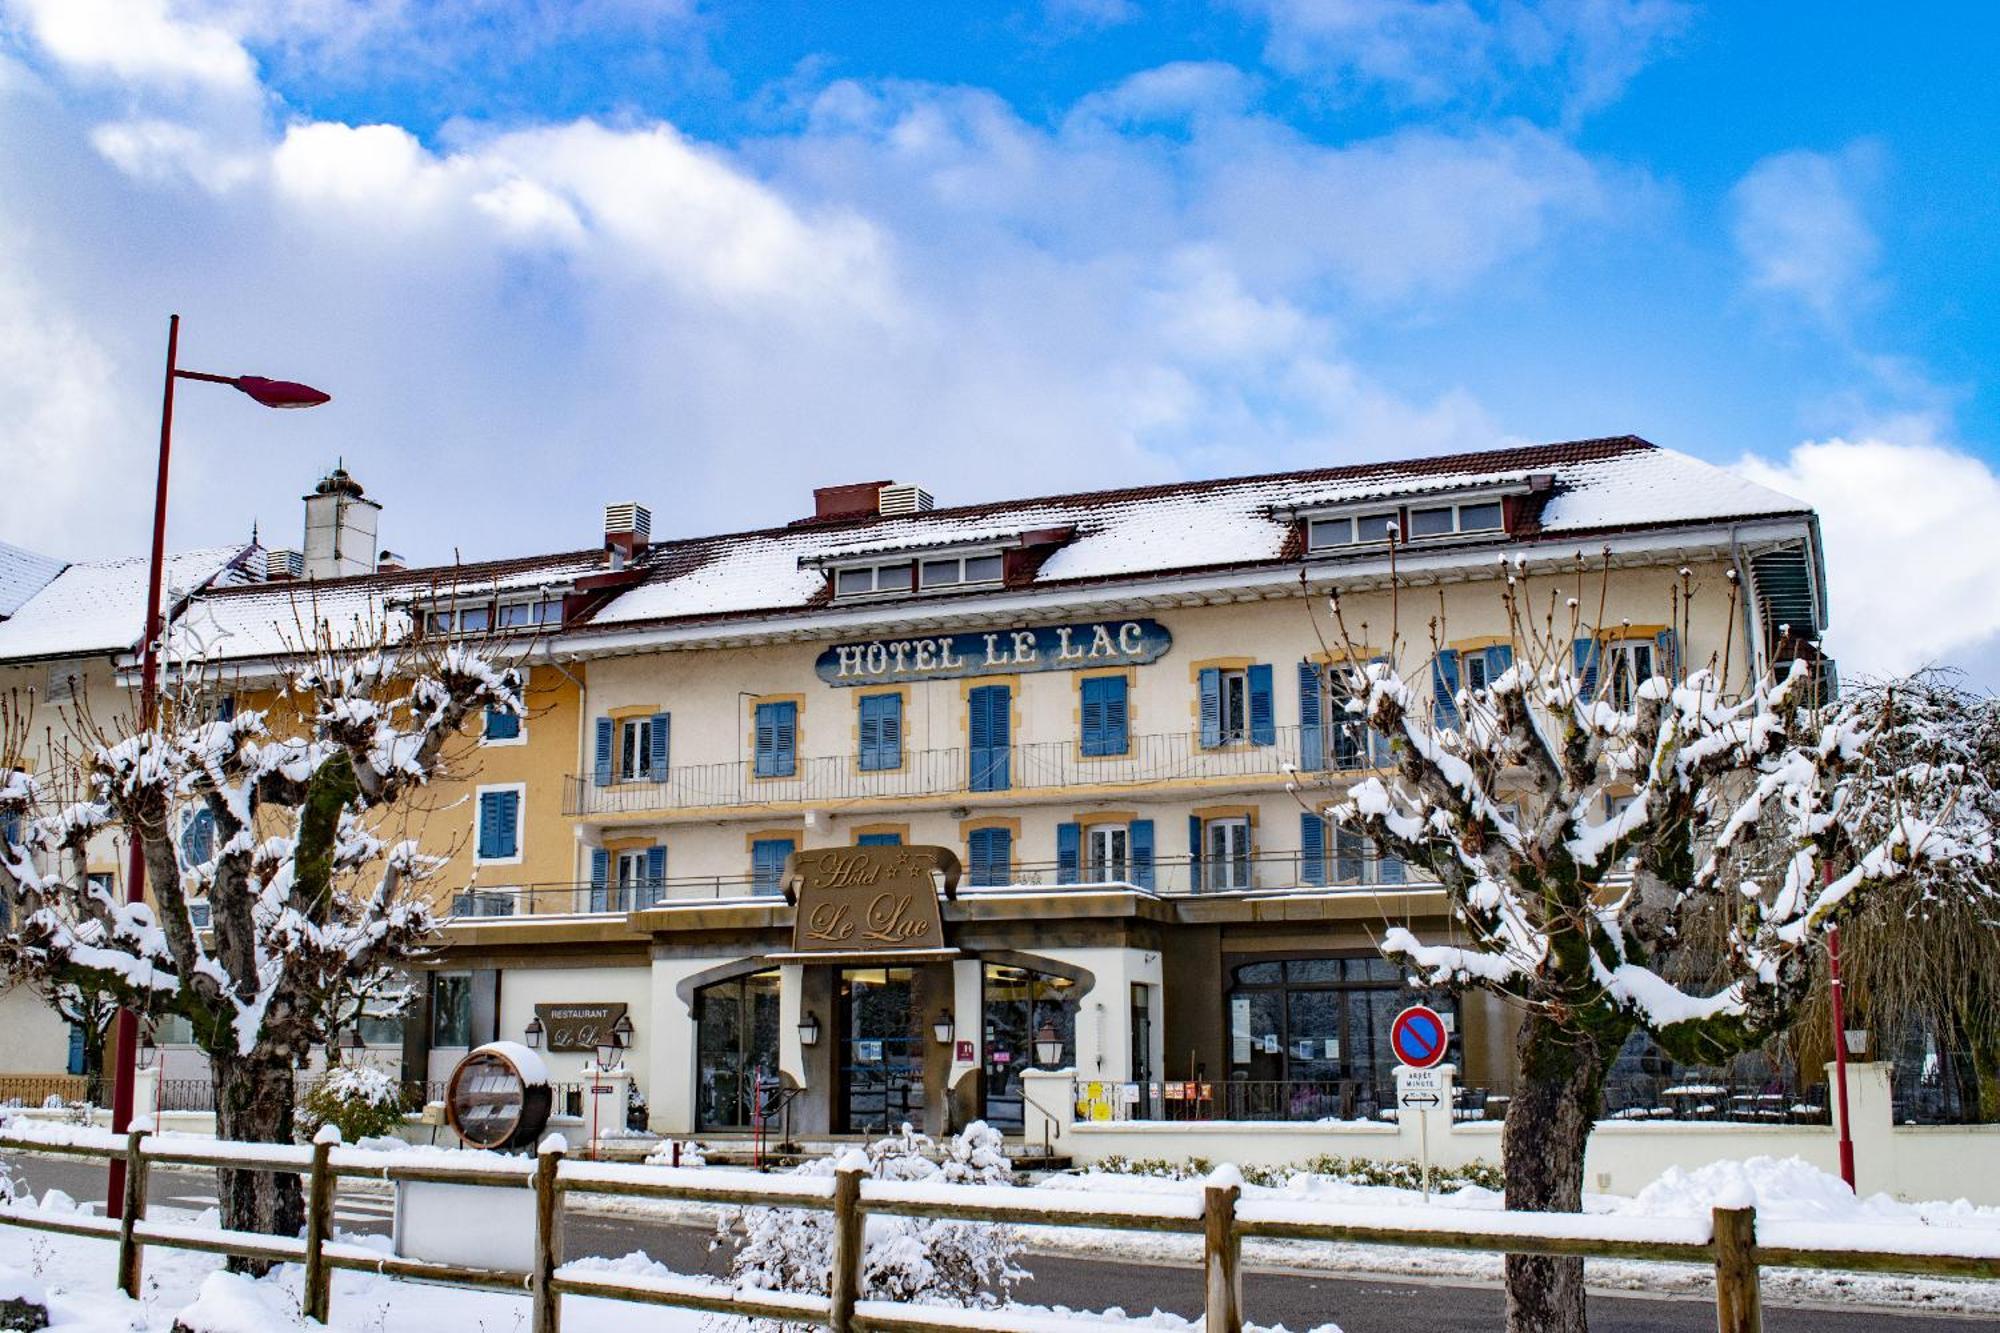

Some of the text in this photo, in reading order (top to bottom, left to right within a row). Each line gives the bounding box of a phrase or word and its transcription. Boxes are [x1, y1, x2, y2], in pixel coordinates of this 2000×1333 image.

[836, 622, 1143, 677] HÔTEL LE LAC
[806, 892, 929, 942] Le Lac
[551, 1009, 609, 1019] RESTAURANT
[552, 1024, 601, 1048] Le La
